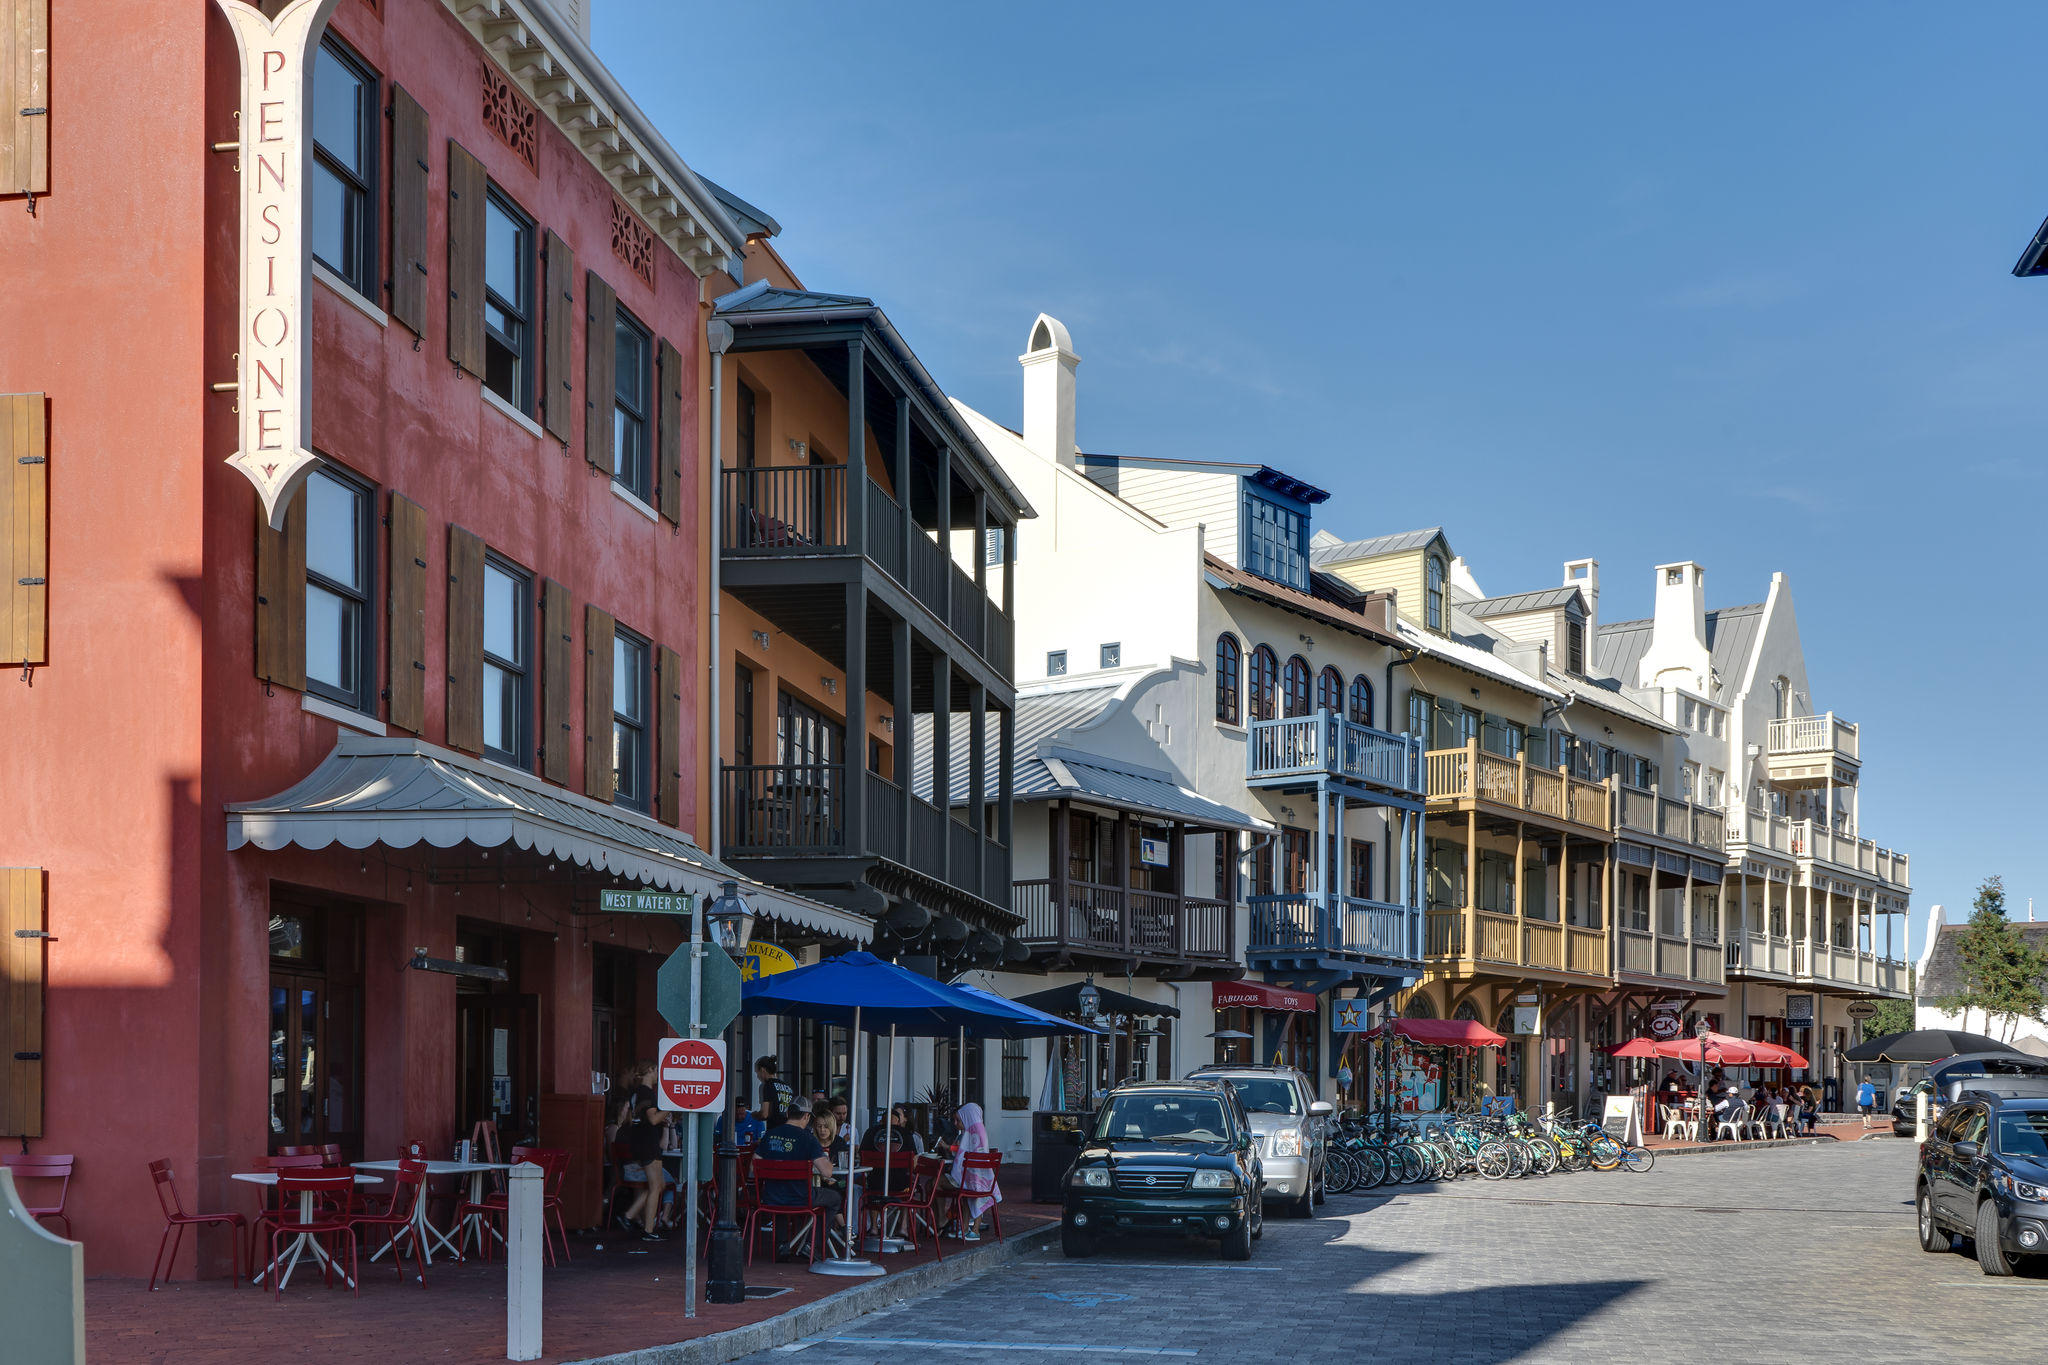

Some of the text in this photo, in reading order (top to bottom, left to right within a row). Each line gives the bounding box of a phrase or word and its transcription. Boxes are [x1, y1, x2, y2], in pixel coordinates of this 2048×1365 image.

[252, 50, 289, 451] PENSIONE
[605, 893, 688, 911] WEST WATER ST.
[748, 943, 783, 962] MMER
[1217, 994, 1299, 1006] FABULOUS TOYS
[1653, 1020, 1675, 1031] CK
[671, 1054, 714, 1066] DO NOT
[673, 1084, 711, 1095] ENTER
